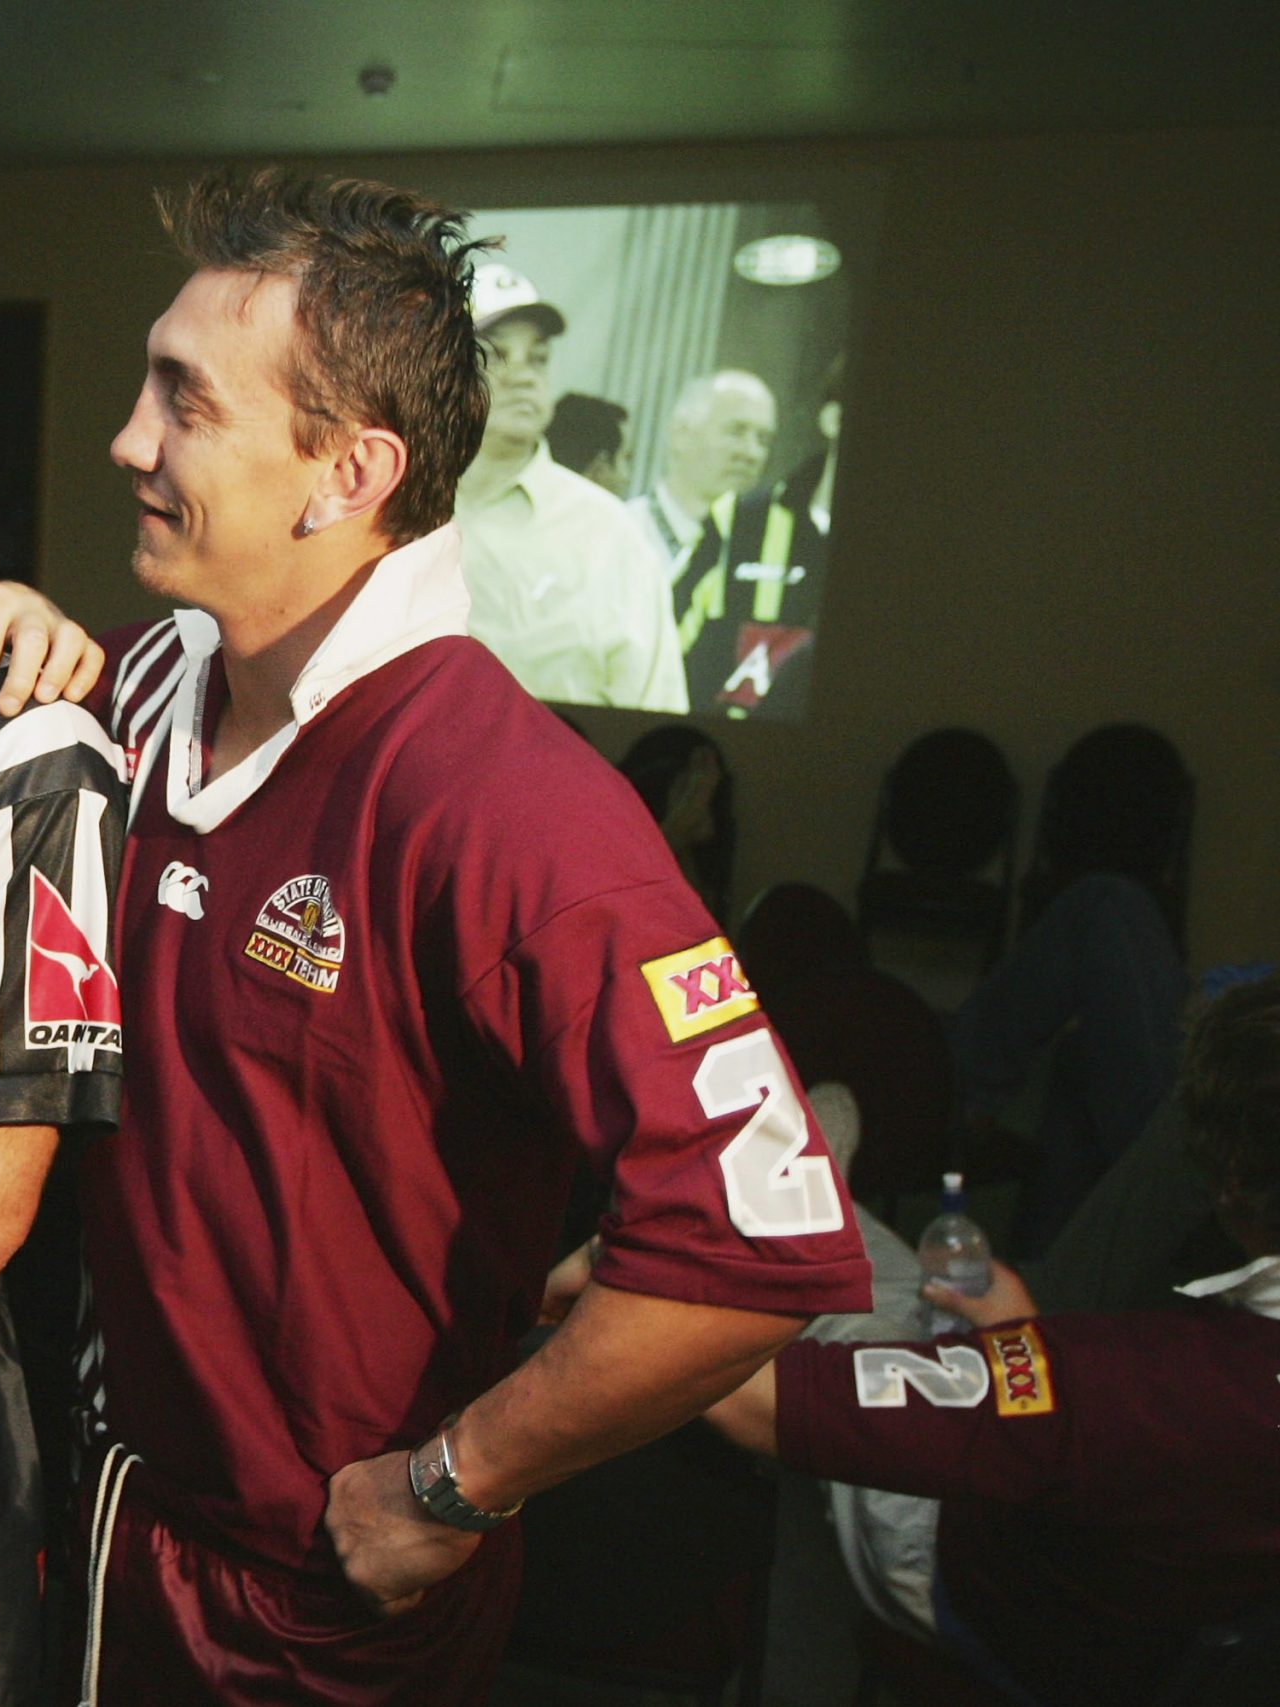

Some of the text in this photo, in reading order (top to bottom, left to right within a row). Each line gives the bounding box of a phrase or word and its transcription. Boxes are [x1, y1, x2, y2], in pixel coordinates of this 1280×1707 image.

[271, 879, 313, 911] STATE
[250, 934, 340, 991] XXXX TEAM
[692, 1027, 845, 1238] 2
[853, 1345, 990, 1409] 2
